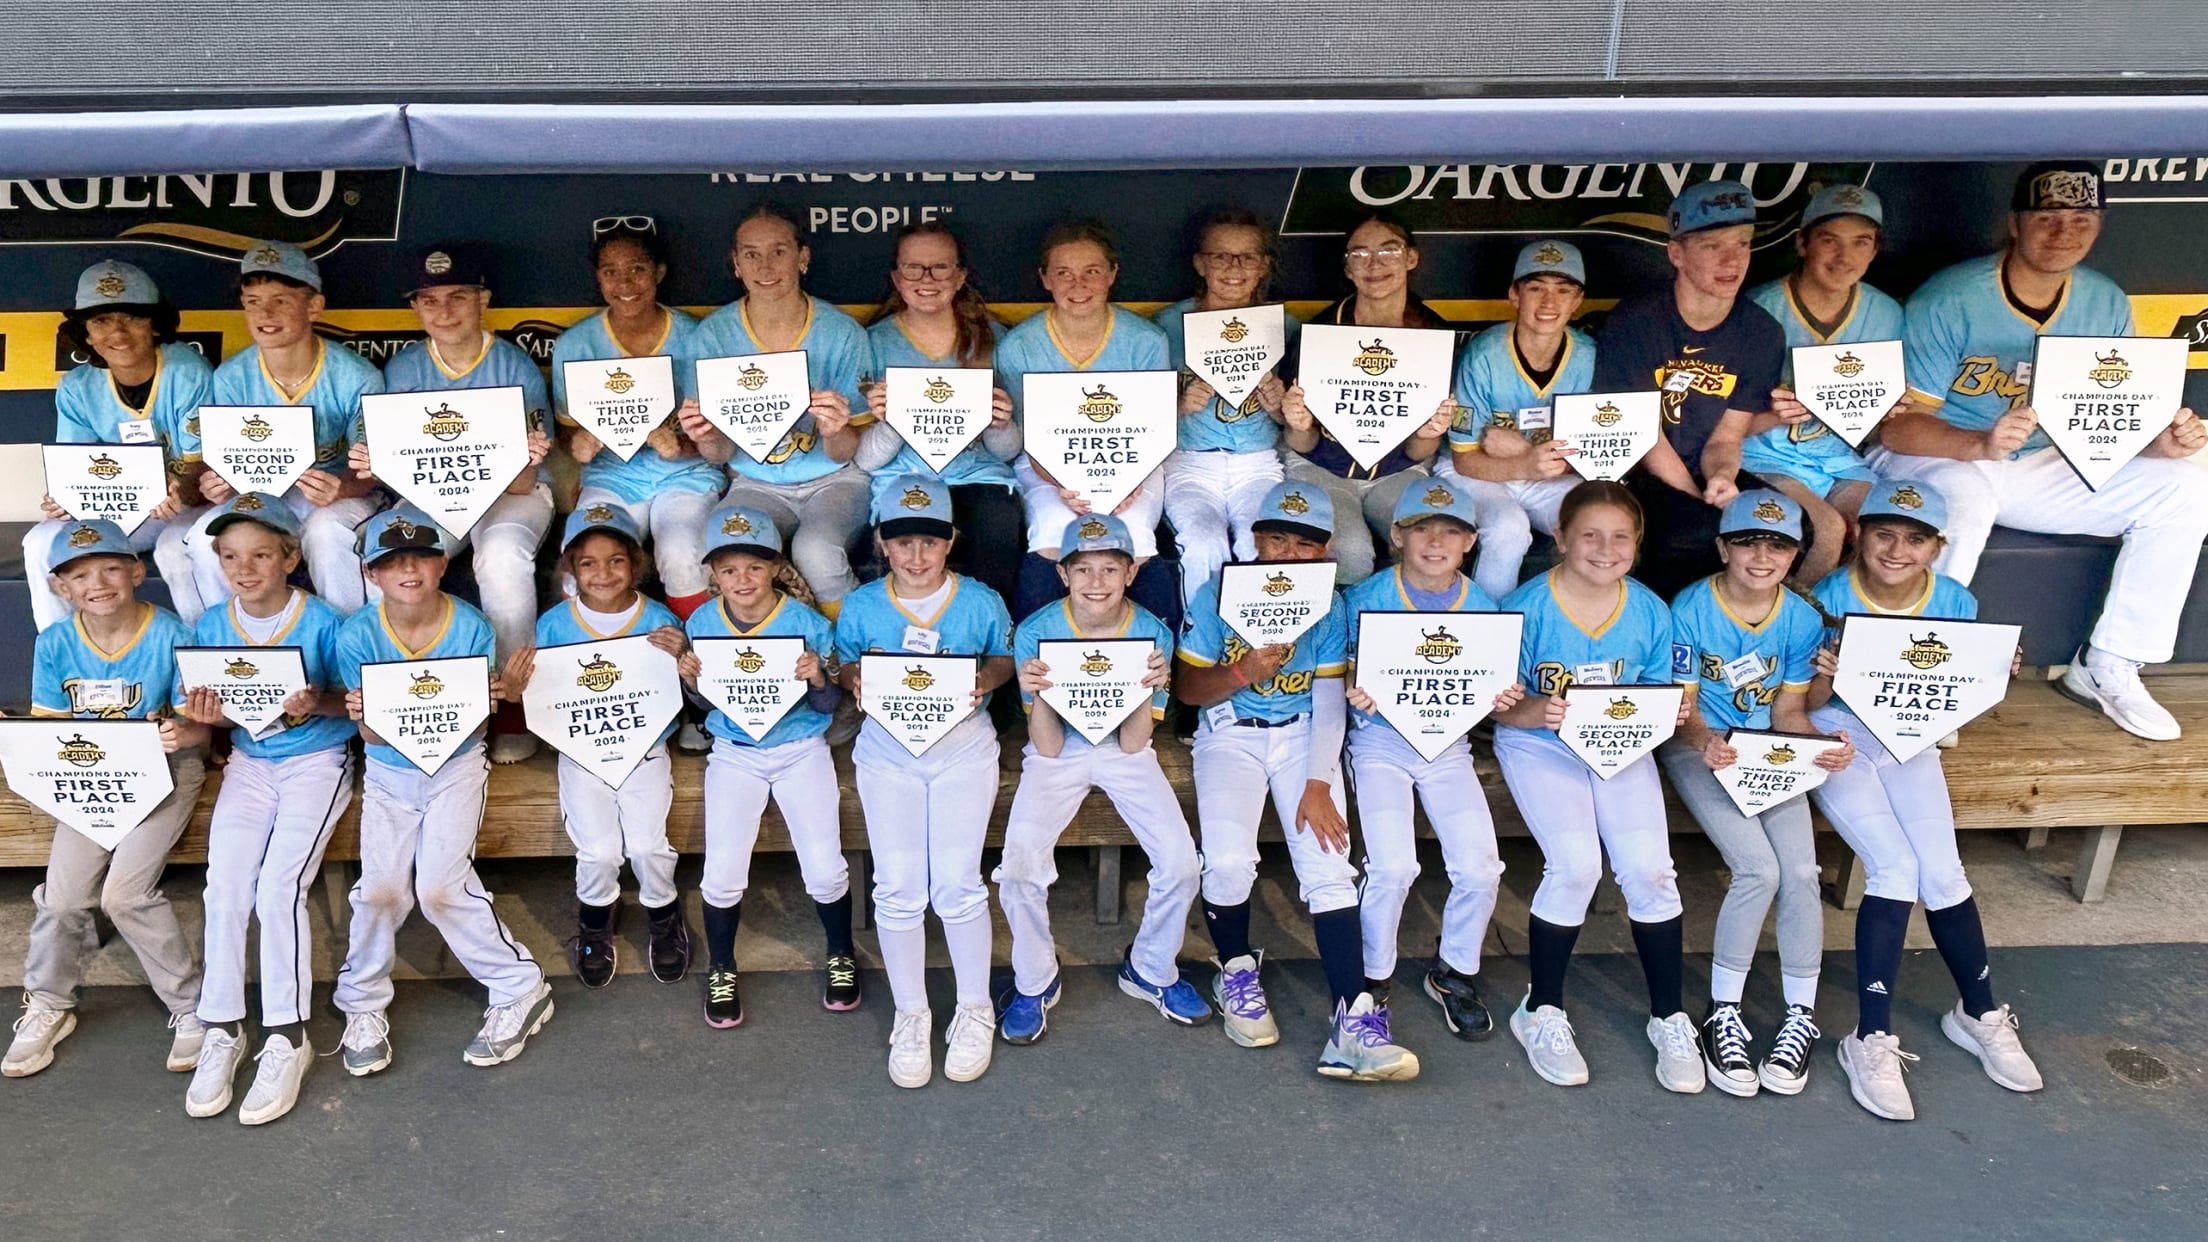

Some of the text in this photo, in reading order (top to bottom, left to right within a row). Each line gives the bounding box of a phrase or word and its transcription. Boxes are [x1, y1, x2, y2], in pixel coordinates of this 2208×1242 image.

[1203, 352, 1267, 366] SECOND
[1211, 363, 1260, 375] PLACE
[1340, 389, 1406, 403] FIRST
[1816, 388, 1886, 401] SECOND
[720, 400, 790, 415] SECOND
[1335, 403, 1409, 417] PLACE
[1826, 399, 1879, 410] PLACE
[2075, 403, 2139, 416] FIRST
[597, 405, 648, 416] THIRD
[597, 414, 650, 427] PLACE
[729, 413, 784, 425] PLACE
[913, 415, 964, 424] THIRD
[1356, 420, 1385, 428] 2024
[2069, 418, 2141, 431] PLACE
[914, 426, 965, 435] PLACE
[1068, 438, 1134, 449] FIRST
[1580, 438, 1631, 448] THIRD
[224, 455, 295, 464] SECOND
[1064, 452, 1138, 464] PLACE
[1579, 449, 1631, 459] PLACE
[416, 454, 485, 470] FIRST
[233, 465, 288, 474] PLACE
[1086, 469, 1115, 477] 2024
[413, 469, 492, 485] PLACE
[439, 486, 470, 496] 2024
[80, 493, 138, 501] THIRD
[81, 503, 140, 512] PLACE
[1240, 607, 1310, 618] SECOND
[1247, 617, 1301, 627] PLACE
[726, 686, 779, 694] THIRD
[1402, 679, 1472, 690] FIRST
[1881, 682, 1958, 697] FIRST
[216, 689, 287, 697] ECOND
[629, 691, 651, 700] DAY
[1069, 689, 1123, 698] THIRD
[220, 697, 279, 705] PLACE
[728, 696, 781, 704] PLACE
[1069, 700, 1124, 708] PLACE
[1396, 693, 1475, 705] PLACE
[1873, 696, 1958, 711] PLACE
[571, 701, 640, 723] FIRST
[882, 702, 954, 712] SECOND
[398, 711, 459, 724] THIRD
[890, 712, 945, 722] PLACE
[1896, 713, 1929, 721] 2024
[400, 723, 460, 737] PLACE
[569, 716, 646, 738] PLACE
[1578, 730, 1653, 739] SECOND
[595, 736, 625, 747] 2024
[1586, 740, 1641, 748] PLACE
[54, 780, 127, 790] FIRST
[54, 792, 137, 803] PLACE
